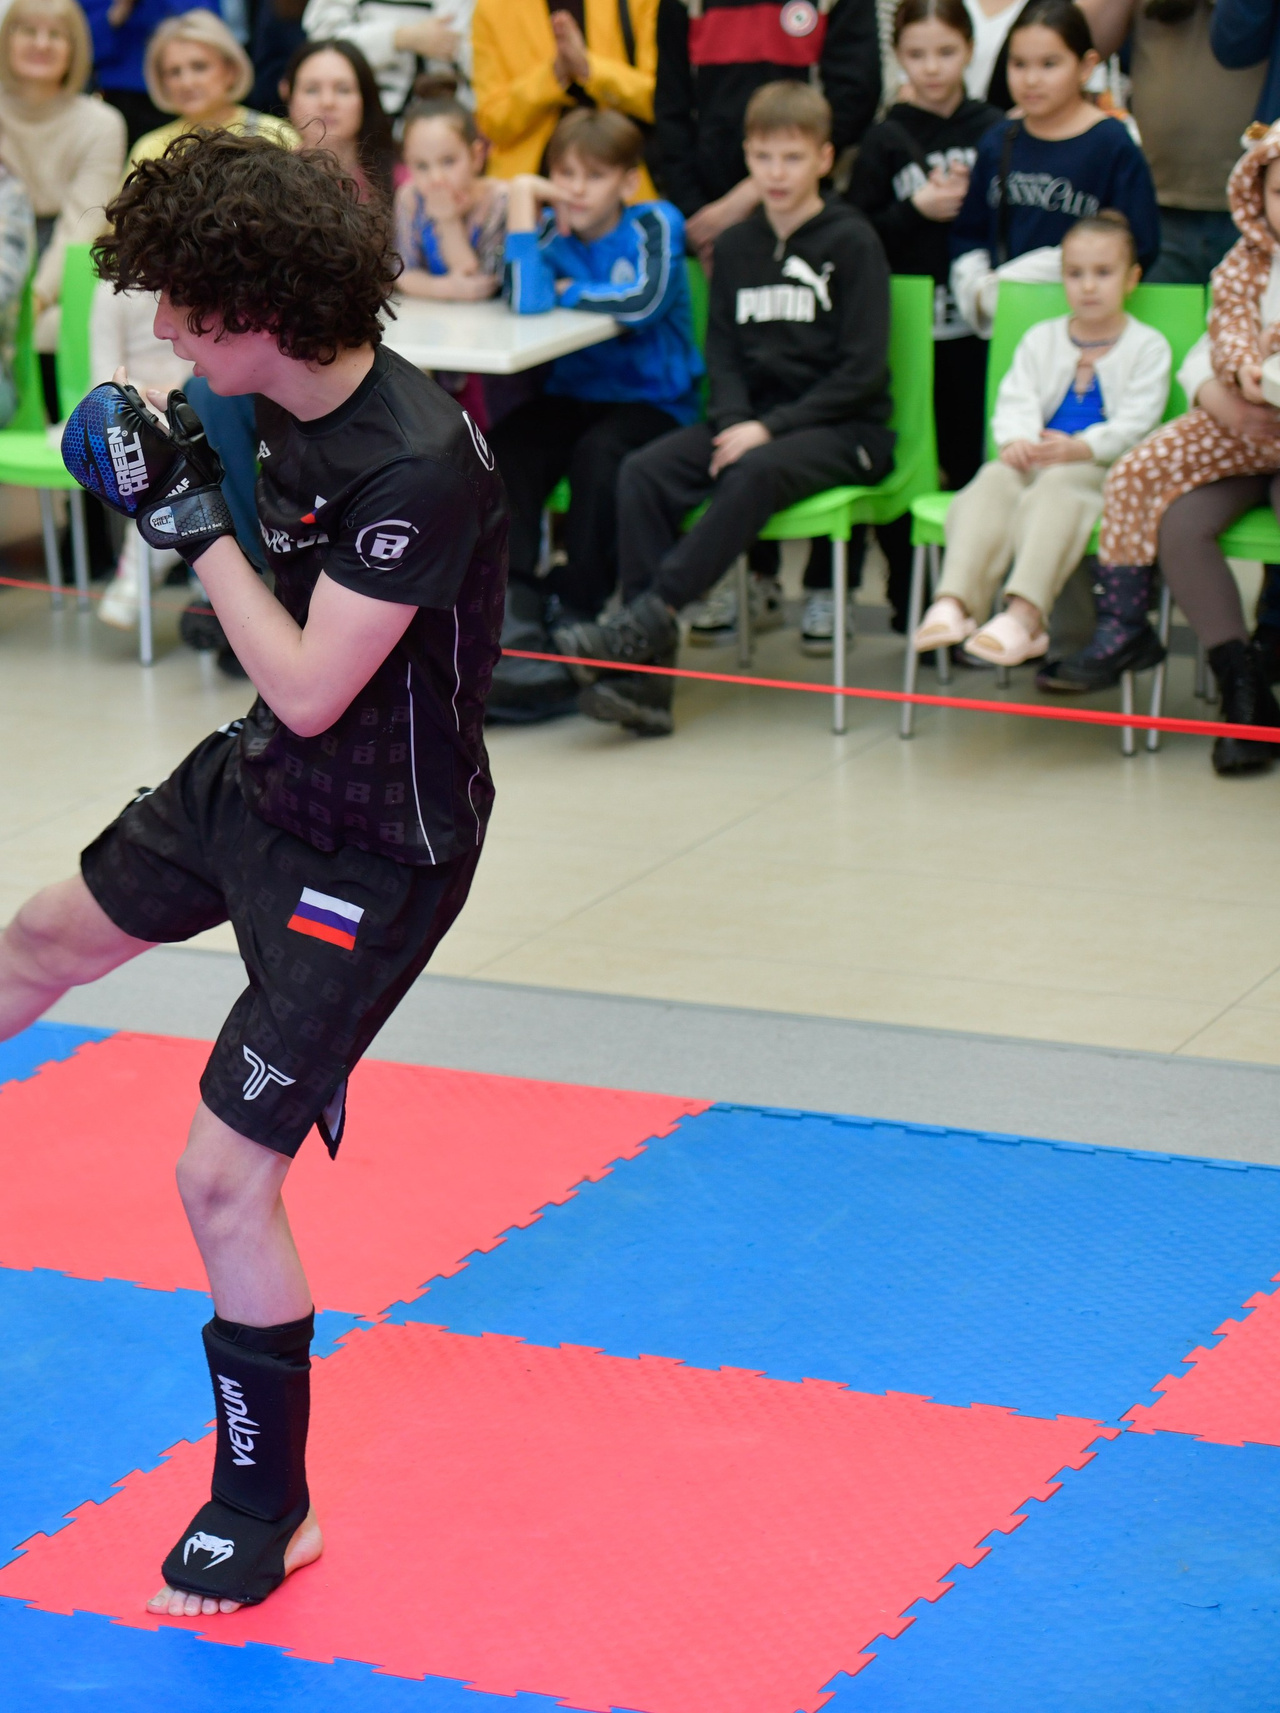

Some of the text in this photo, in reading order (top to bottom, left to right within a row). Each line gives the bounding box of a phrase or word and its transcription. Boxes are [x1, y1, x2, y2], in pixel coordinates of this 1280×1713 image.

[736, 284, 816, 325] PUMA
[107, 426, 133, 497] GREEN
[125, 431, 150, 493] HILL
[152, 514, 173, 523] GREEN
[154, 519, 168, 527] HILL
[370, 532, 410, 560] B
[216, 1374, 261, 1467] VENUM
